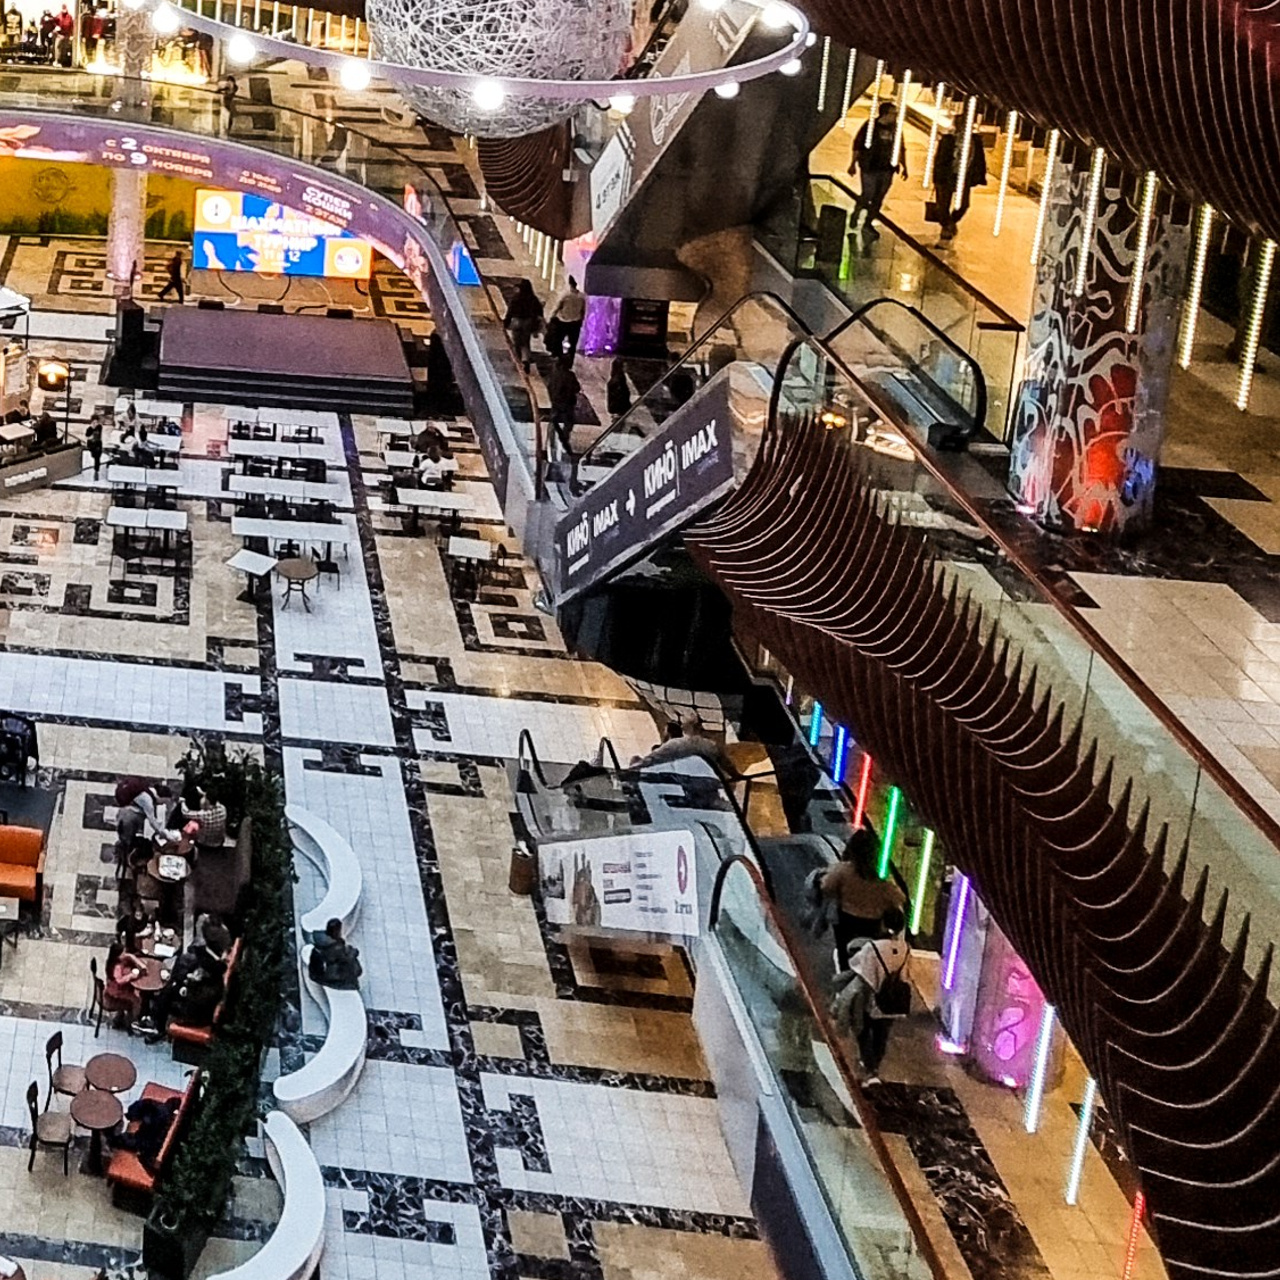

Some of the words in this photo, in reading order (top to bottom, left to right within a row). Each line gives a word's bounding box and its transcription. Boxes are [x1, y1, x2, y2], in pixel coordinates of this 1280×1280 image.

[121, 137, 138, 151] 2
[141, 144, 211, 164] ОКТЯБРЯ
[130, 152, 148, 165] 9
[152, 159, 213, 178] НОЯБРЯ
[302, 192, 353, 220] КОШКИ
[305, 186, 351, 209] СУПЕР
[288, 251, 301, 262] 12
[681, 419, 718, 470] IMAX
[593, 499, 619, 537] IMAX
